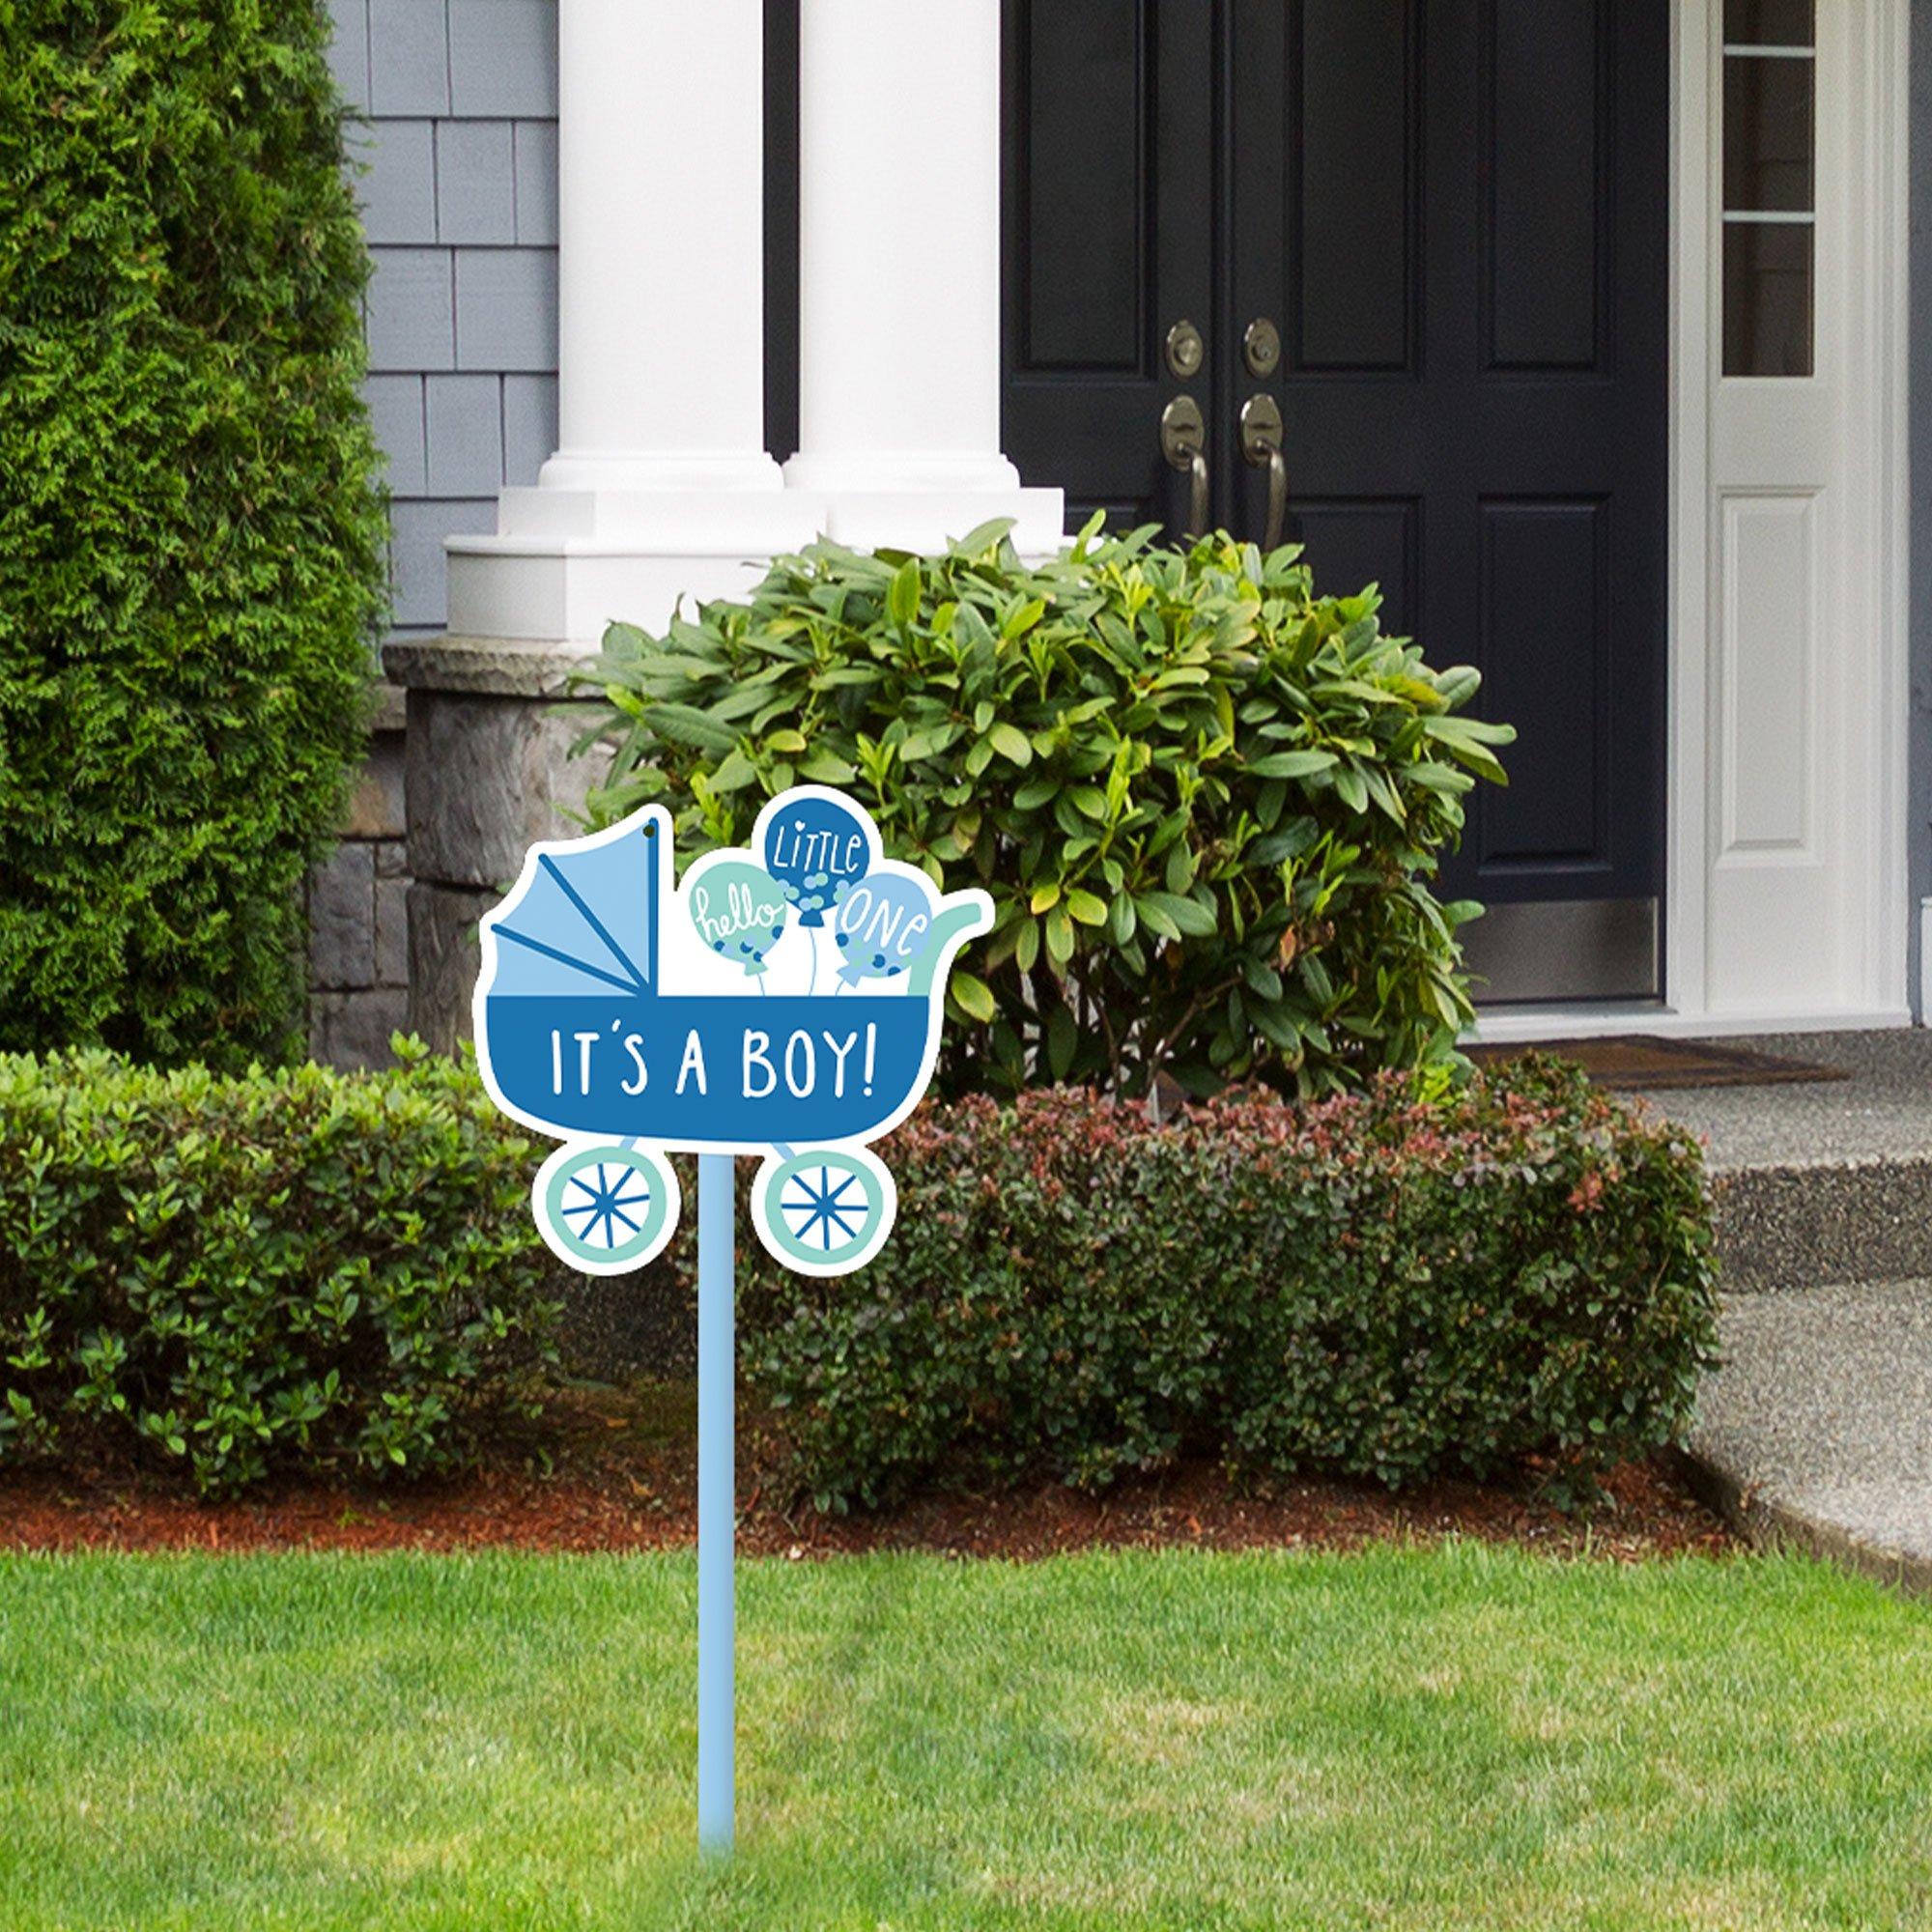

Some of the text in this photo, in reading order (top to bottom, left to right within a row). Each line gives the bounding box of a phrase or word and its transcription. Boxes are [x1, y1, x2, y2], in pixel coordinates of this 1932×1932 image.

[696, 883, 784, 942] hello
[552, 1019, 877, 1098] IT'S A BOY!
